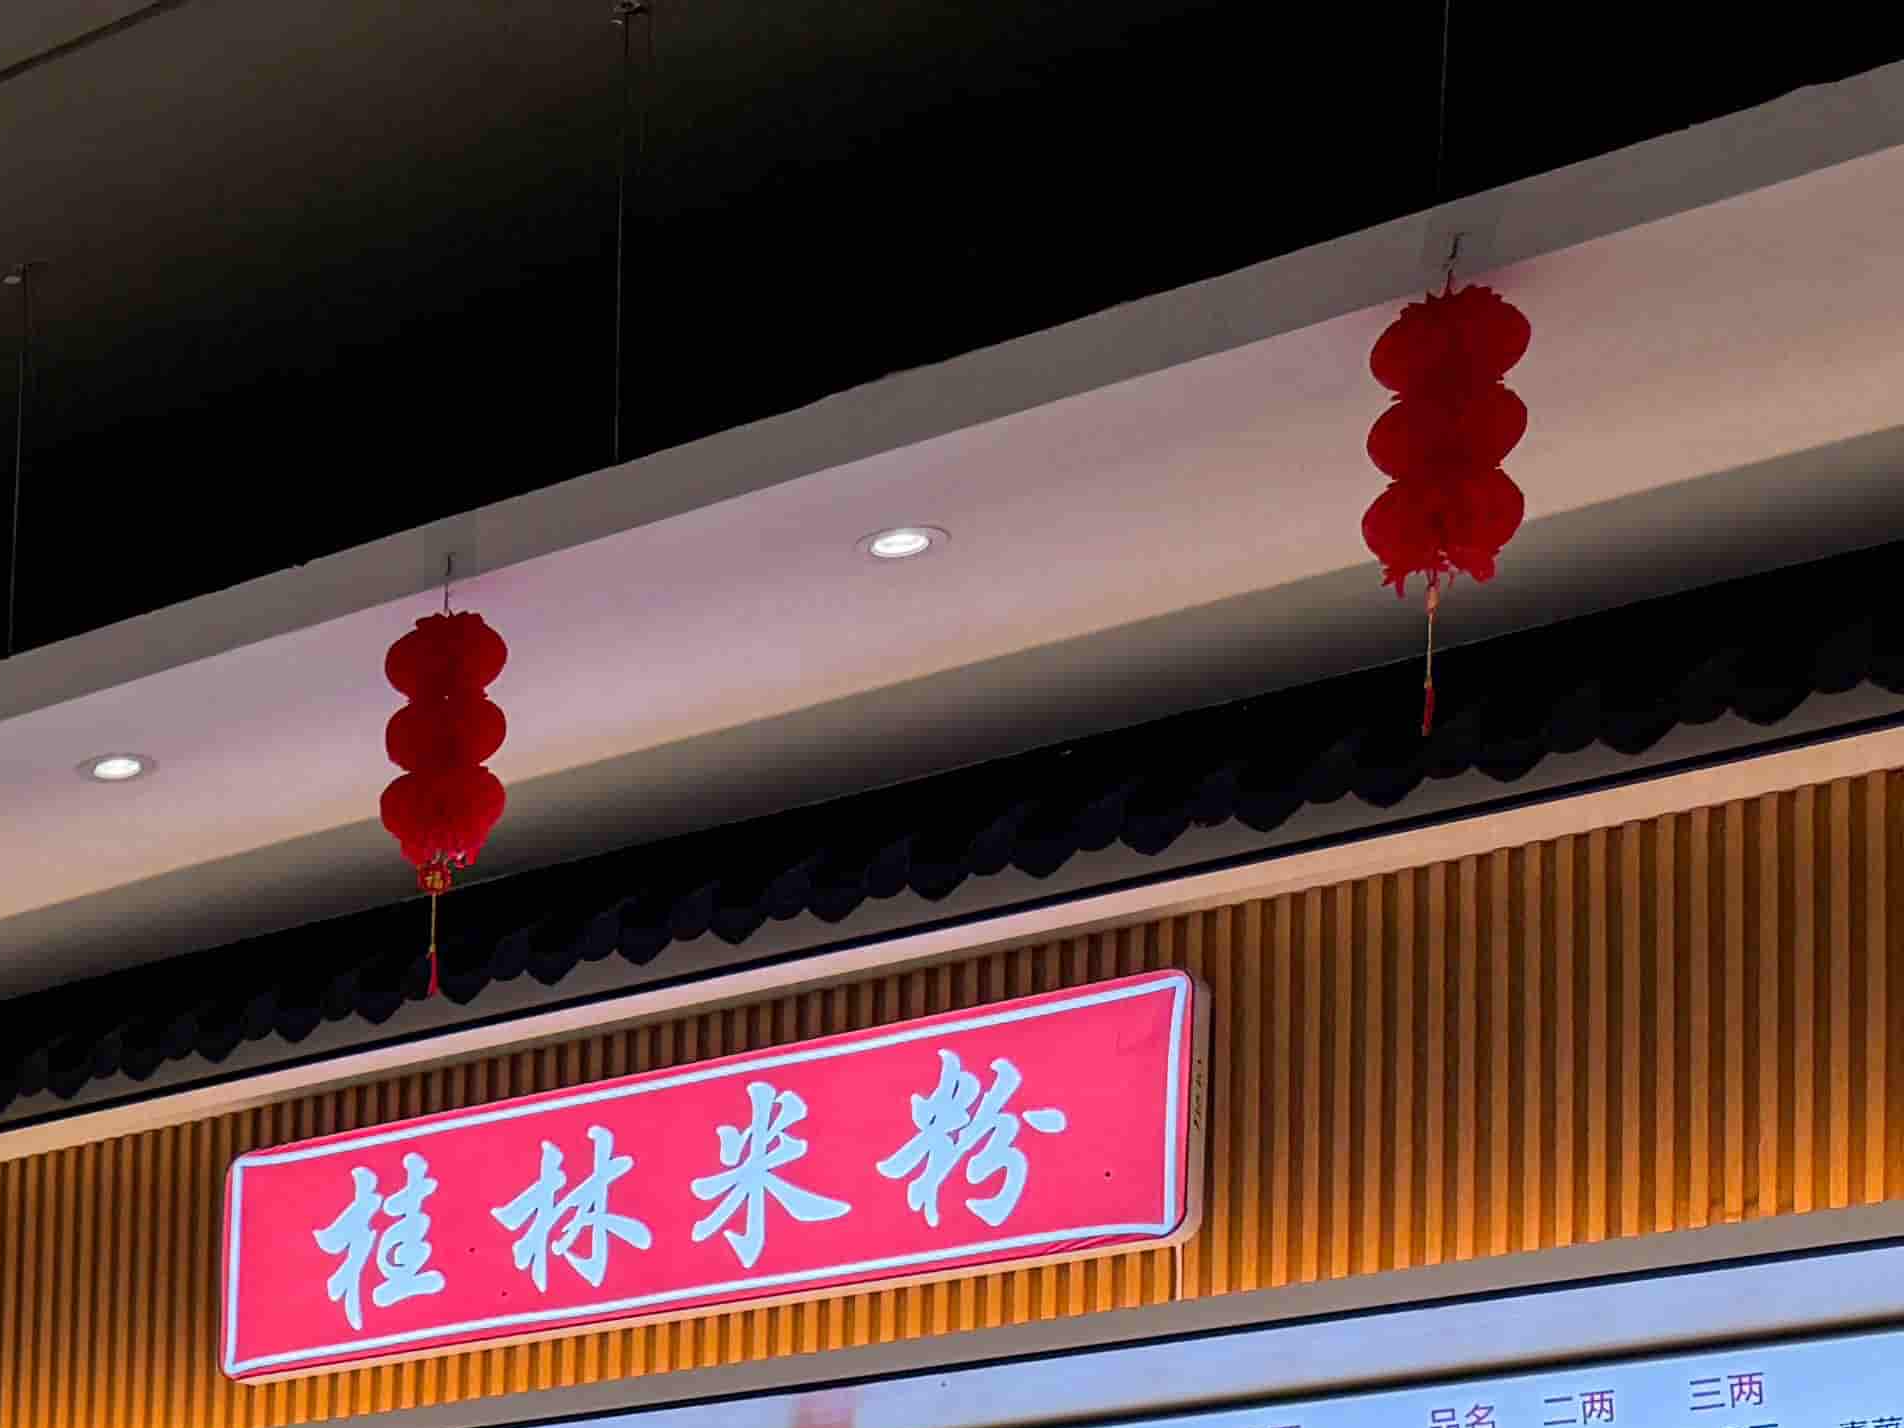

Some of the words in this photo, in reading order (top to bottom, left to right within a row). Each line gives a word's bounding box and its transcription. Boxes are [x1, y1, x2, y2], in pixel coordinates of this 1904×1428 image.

[313, 1048, 1066, 1331] 桂林米粉
[1544, 1389, 1616, 1427] 二两
[1689, 1371, 1765, 1412] 三两
